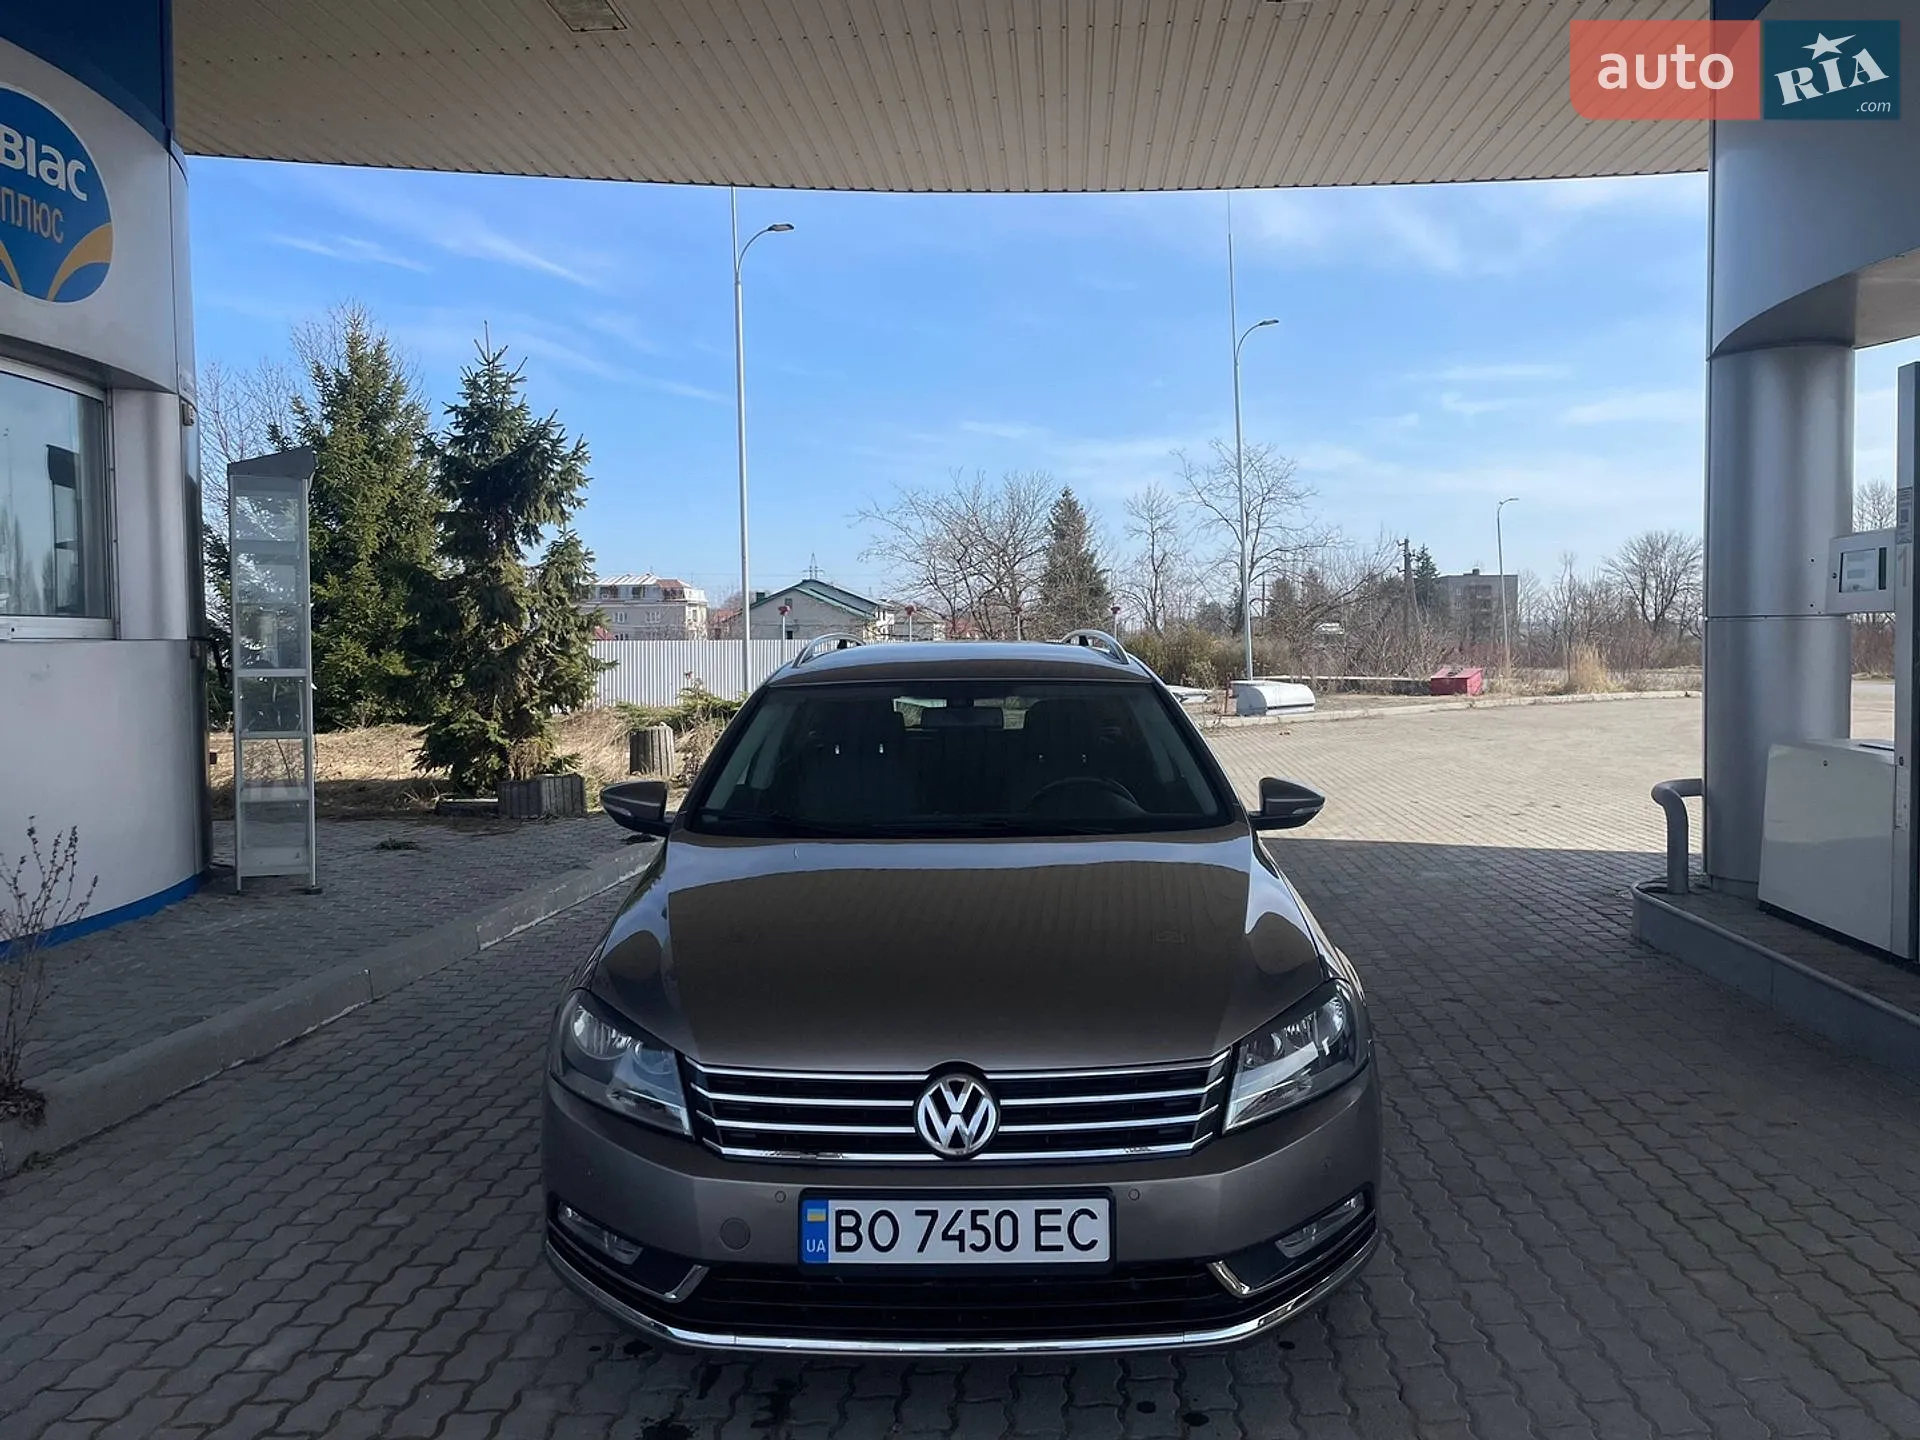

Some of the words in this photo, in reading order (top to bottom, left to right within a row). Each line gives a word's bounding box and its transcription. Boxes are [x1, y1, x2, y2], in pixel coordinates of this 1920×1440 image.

[834, 1209, 900, 1253] BO
[914, 1209, 1020, 1253] 7450
[1034, 1208, 1099, 1252] EC
[806, 1239, 826, 1253] UA
